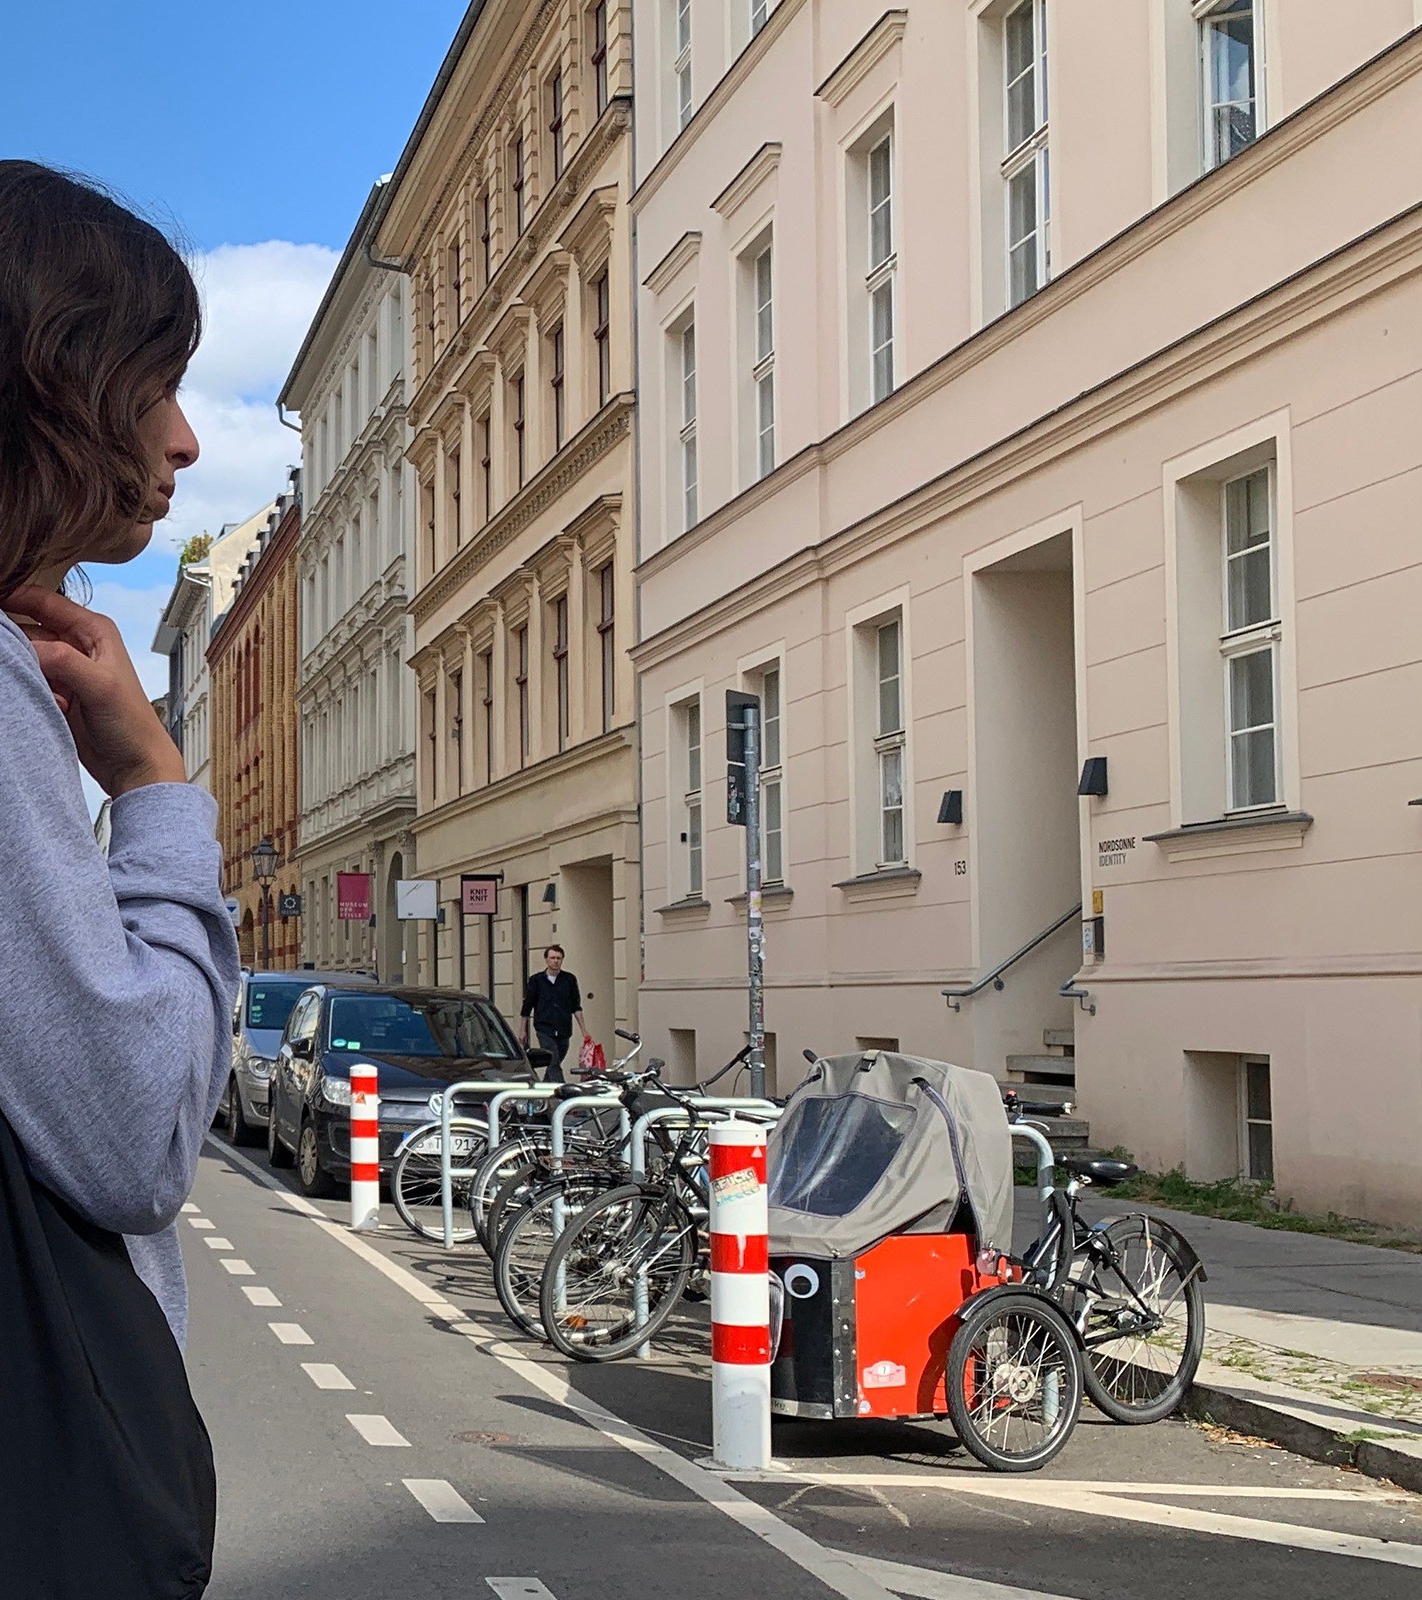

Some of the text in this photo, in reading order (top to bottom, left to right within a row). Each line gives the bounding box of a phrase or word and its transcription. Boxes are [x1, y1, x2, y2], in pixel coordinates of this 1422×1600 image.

[1099, 837, 1135, 853] NORDSONNE
[954, 860, 966, 875] 153
[1099, 853, 1126, 867] IDENTITY
